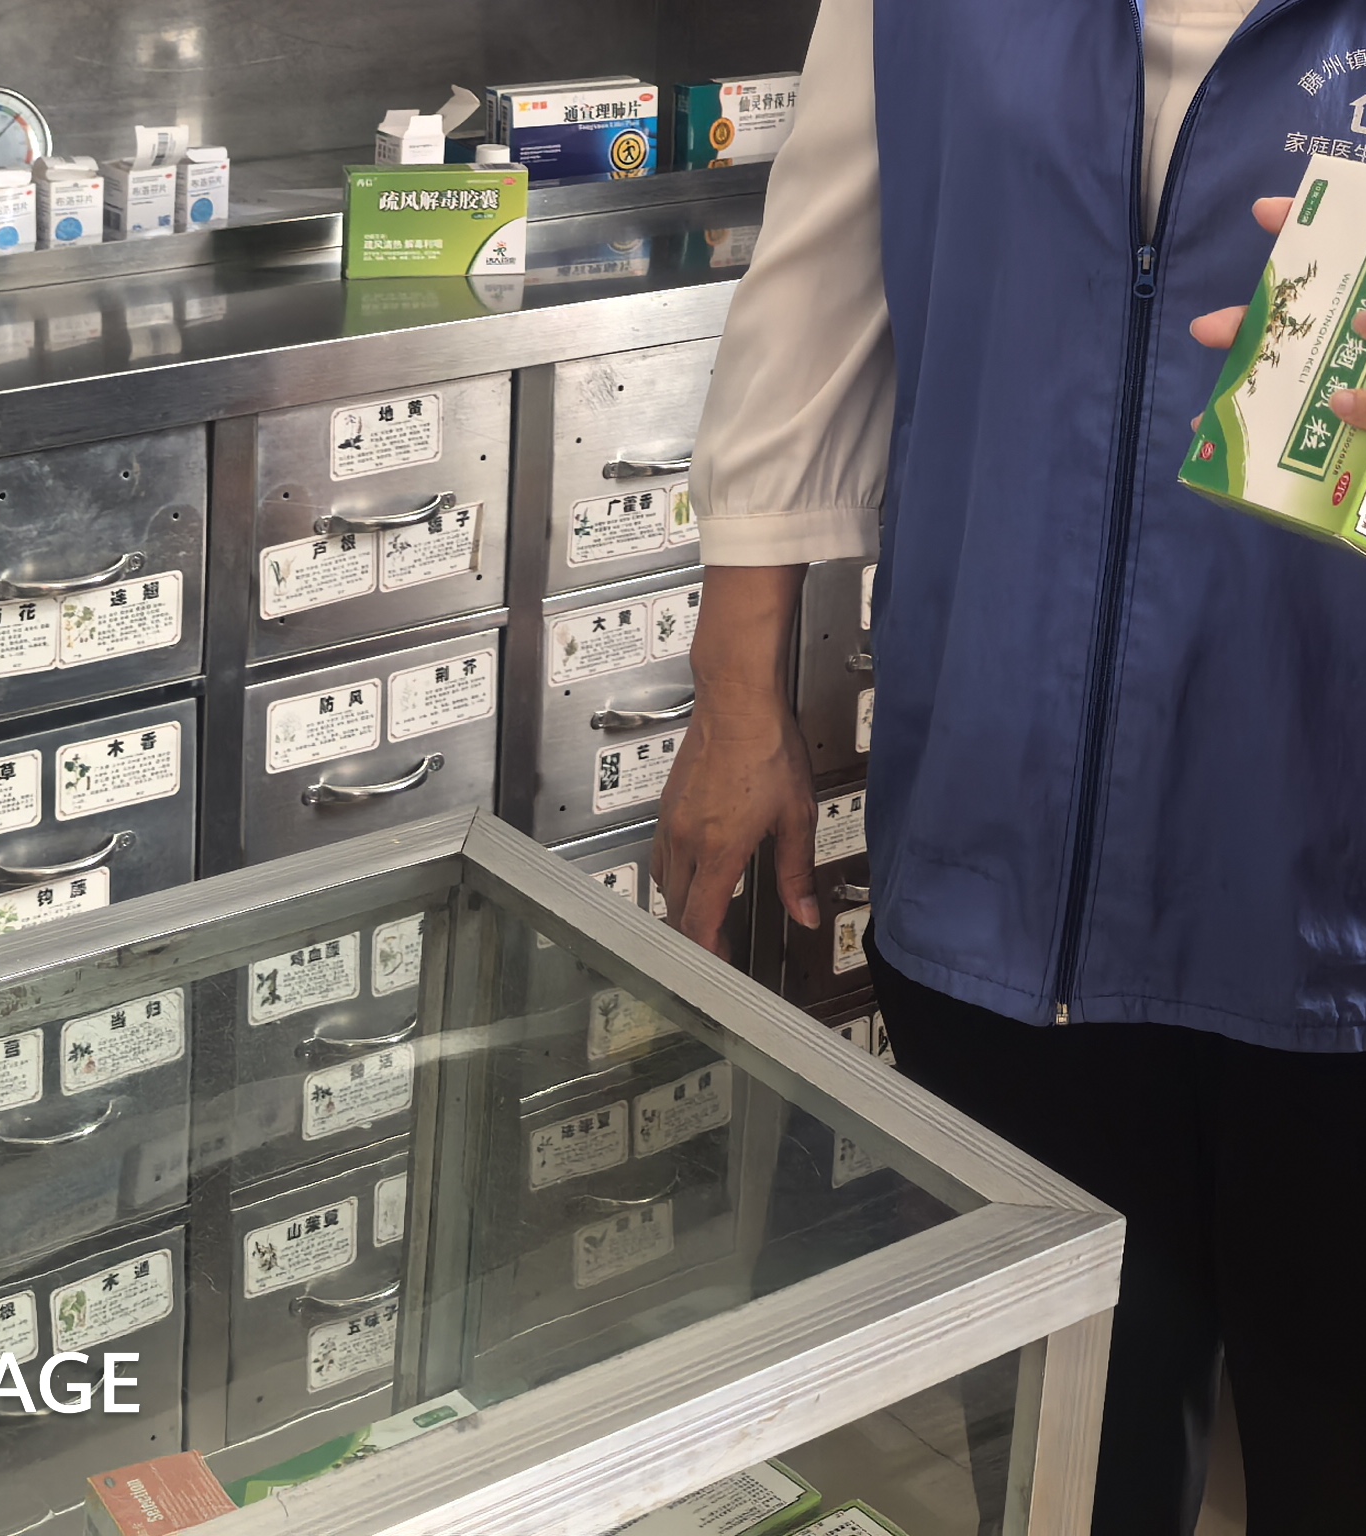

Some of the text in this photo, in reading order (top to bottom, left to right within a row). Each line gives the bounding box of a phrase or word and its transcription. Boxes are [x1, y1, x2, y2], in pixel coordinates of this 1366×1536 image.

[564, 100, 642, 123] 通宣理肺片
[738, 91, 797, 114] 仙灵骨葆片
[55, 195, 93, 207] 布洛芬片
[379, 188, 500, 212] 疏风解毒胶囊
[379, 399, 423, 422] 地黄
[1333, 472, 1351, 504] OTC
[607, 493, 654, 516] 广藿香
[312, 533, 357, 561] 芦根
[110, 581, 161, 607] 连翘
[592, 609, 633, 633] 大黄
[435, 658, 477, 684] 荆芥
[318, 689, 364, 715] 防风
[107, 731, 159, 758] 木香
[636, 736, 676, 761] 芒硝
[826, 796, 863, 819] 木瓜
[37, 879, 89, 909] 钩藤
[110, 1000, 162, 1031] 当归
[102, 1259, 151, 1293] 木通
[347, 1303, 400, 1336] 五味子
